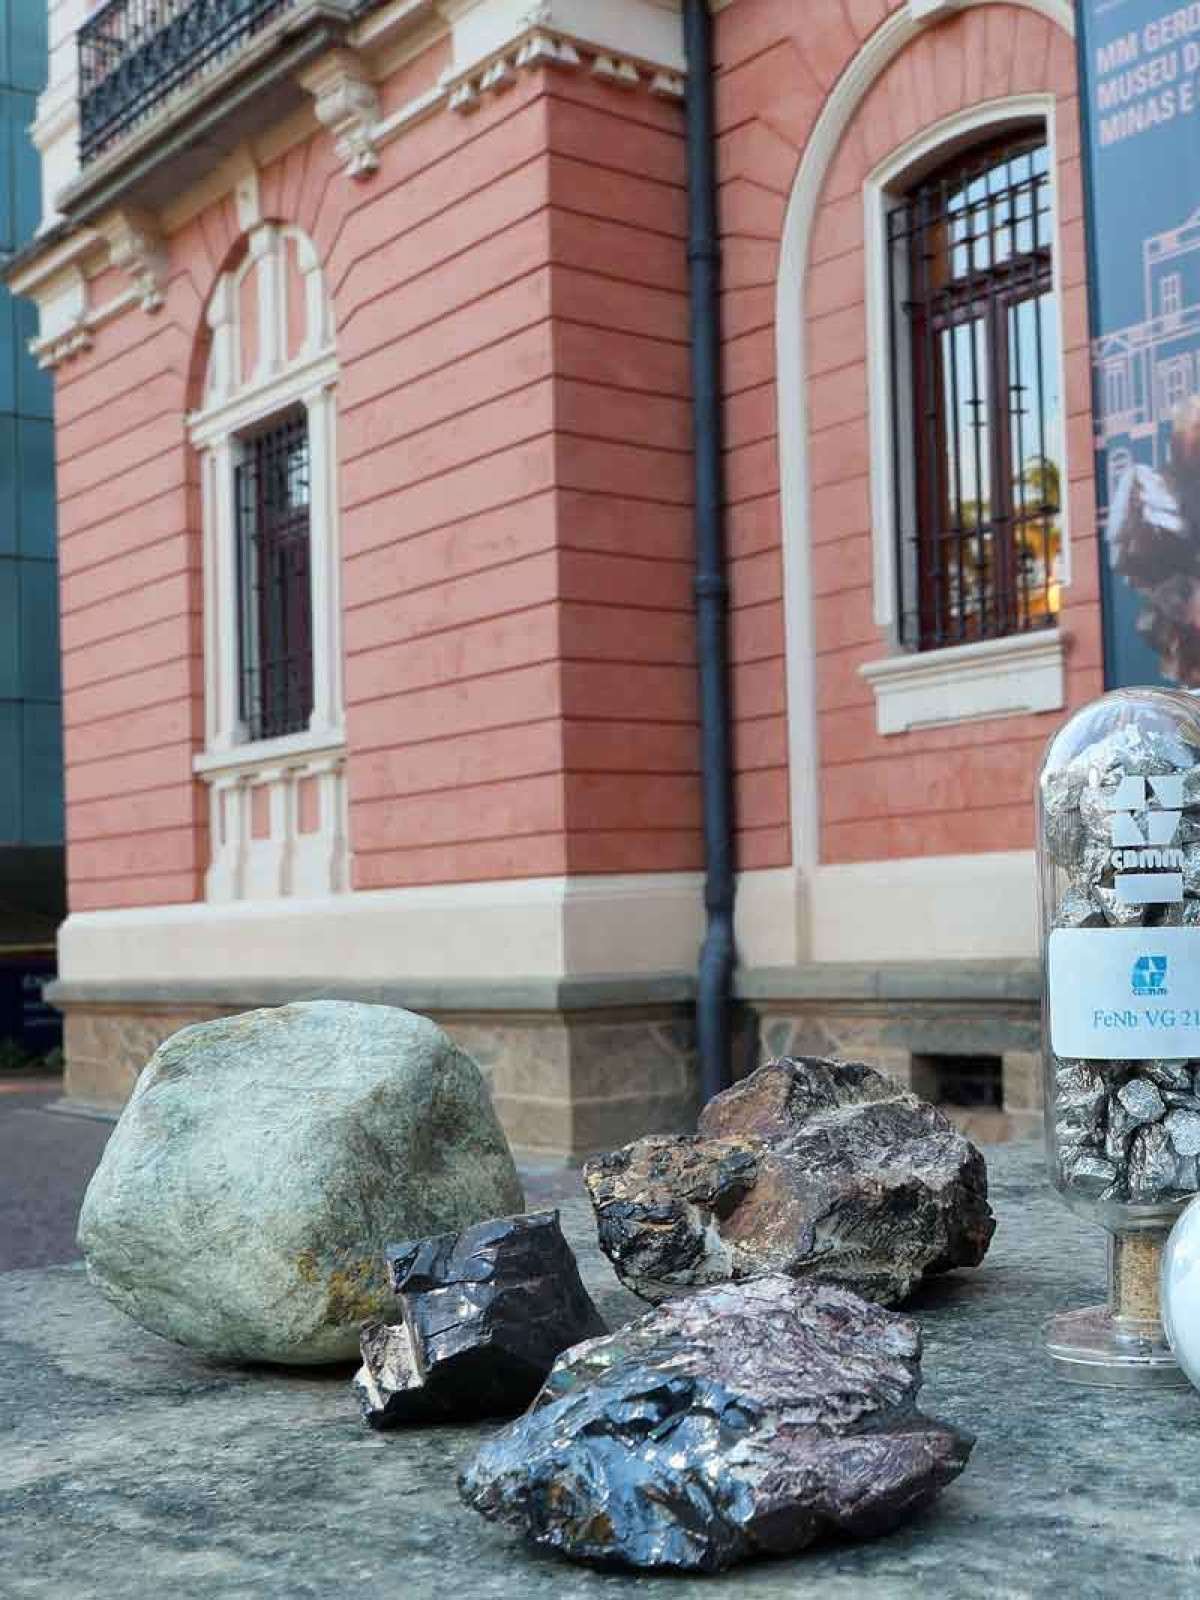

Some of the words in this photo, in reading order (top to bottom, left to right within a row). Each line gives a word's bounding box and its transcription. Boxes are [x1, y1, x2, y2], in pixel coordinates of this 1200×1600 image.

[1096, 33, 1138, 73] MM
[1097, 52, 1177, 110] MUSEU
[1099, 92, 1176, 145] MINAS
[1180, 82, 1194, 113] E
[1093, 1008, 1138, 1028] FeNb
[1145, 1008, 1177, 1027] VG
